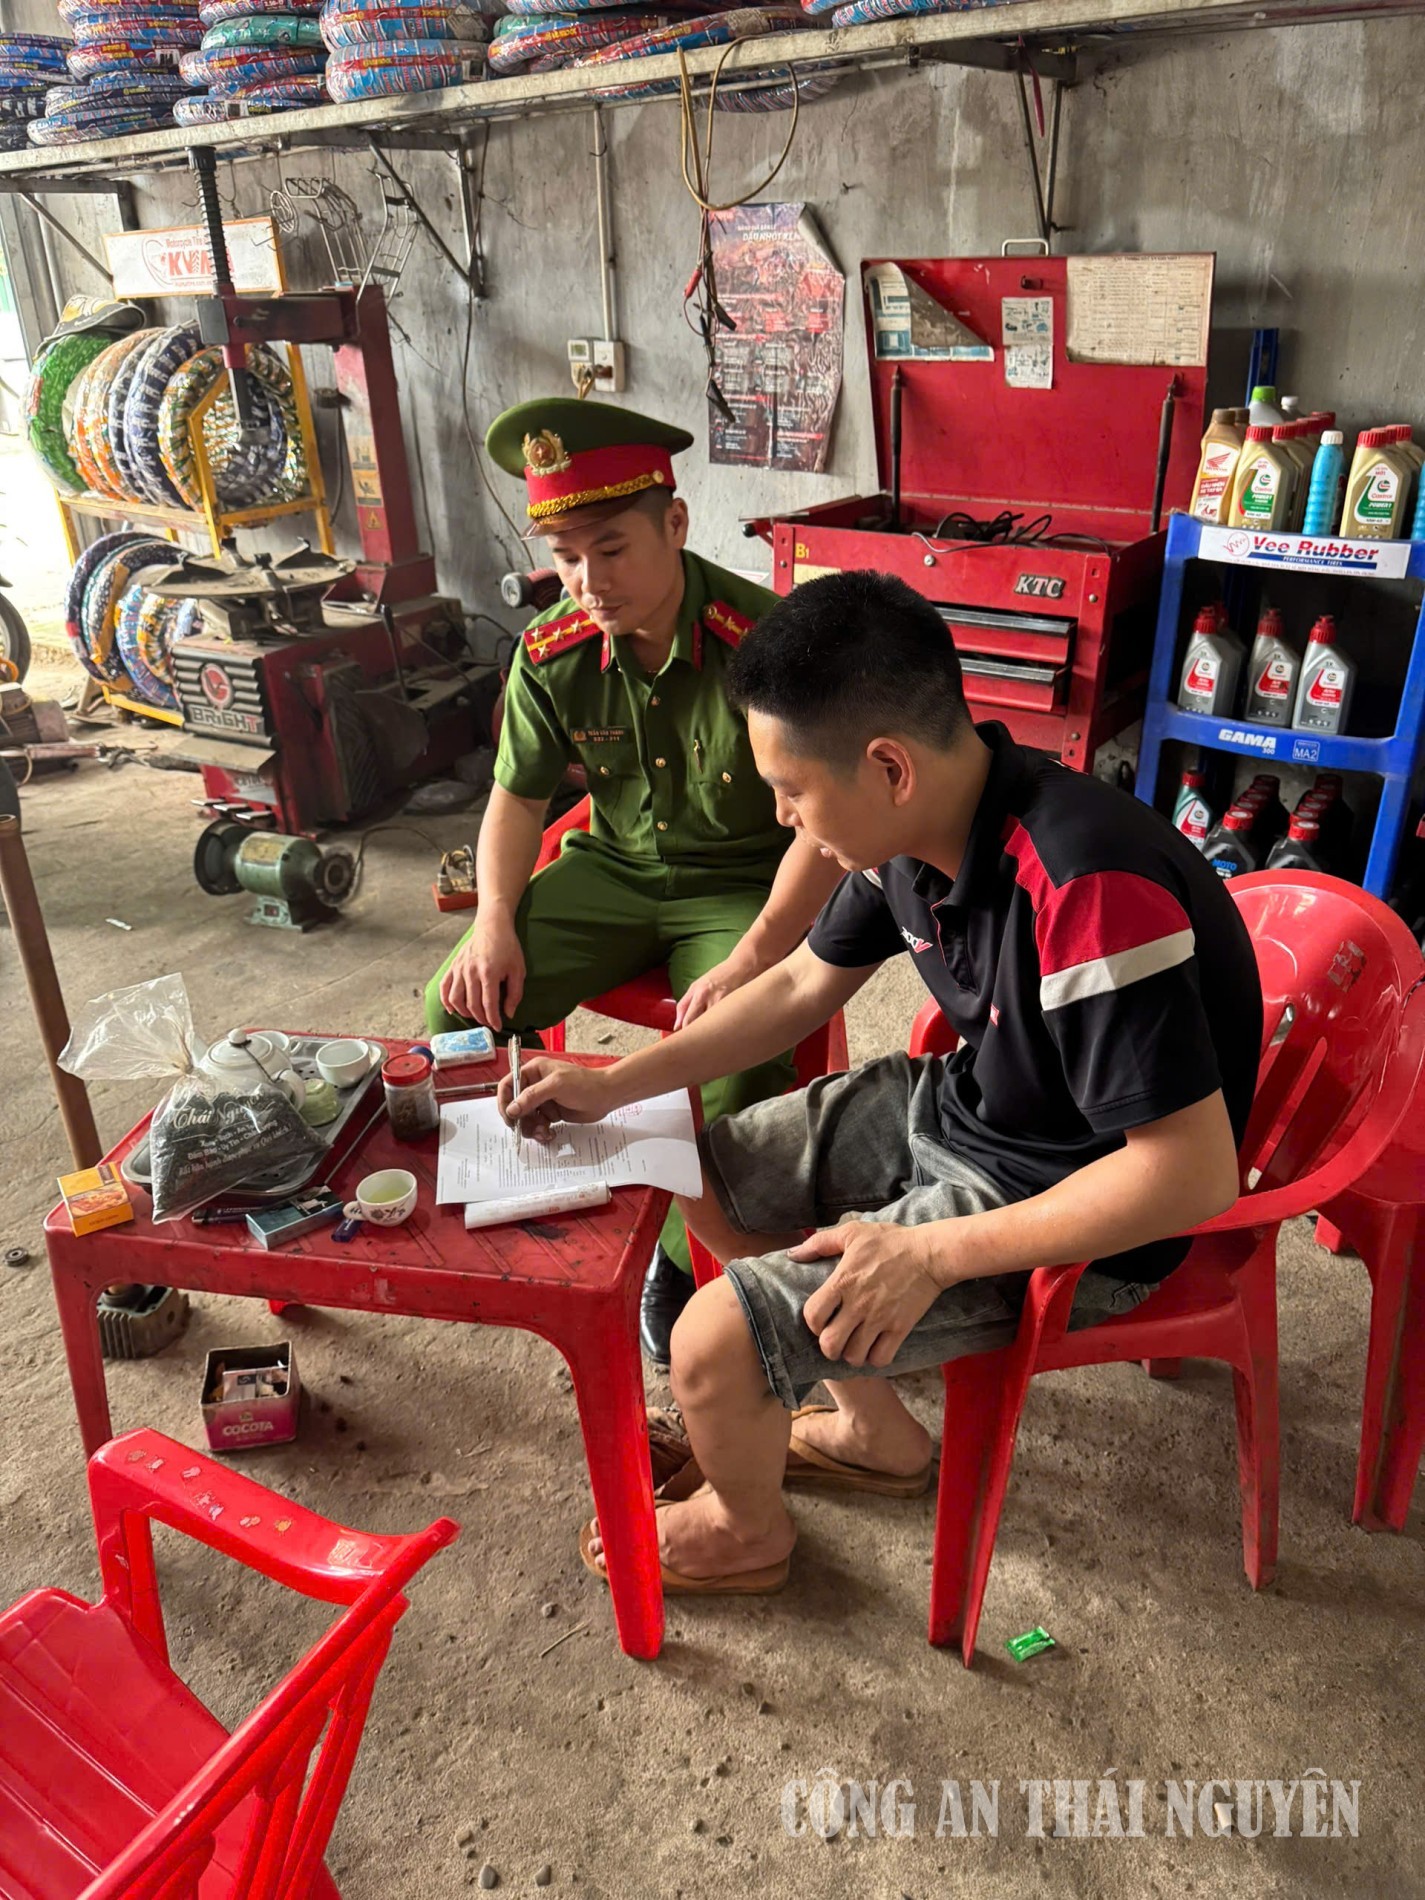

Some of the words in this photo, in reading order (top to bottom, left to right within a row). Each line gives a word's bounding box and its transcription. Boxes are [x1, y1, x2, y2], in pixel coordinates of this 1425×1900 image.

[1253, 535, 1291, 555] Vee
[1297, 540, 1379, 561] Rubber
[1282, 556, 1326, 566] PERFORMANCE
[1015, 575, 1063, 598] KTC
[1219, 729, 1276, 748] GAMA
[1294, 747, 1318, 760] MA2
[1212, 858, 1237, 871] MOTO
[173, 1104, 213, 1130] Thái
[223, 1422, 274, 1435] COCOTA
